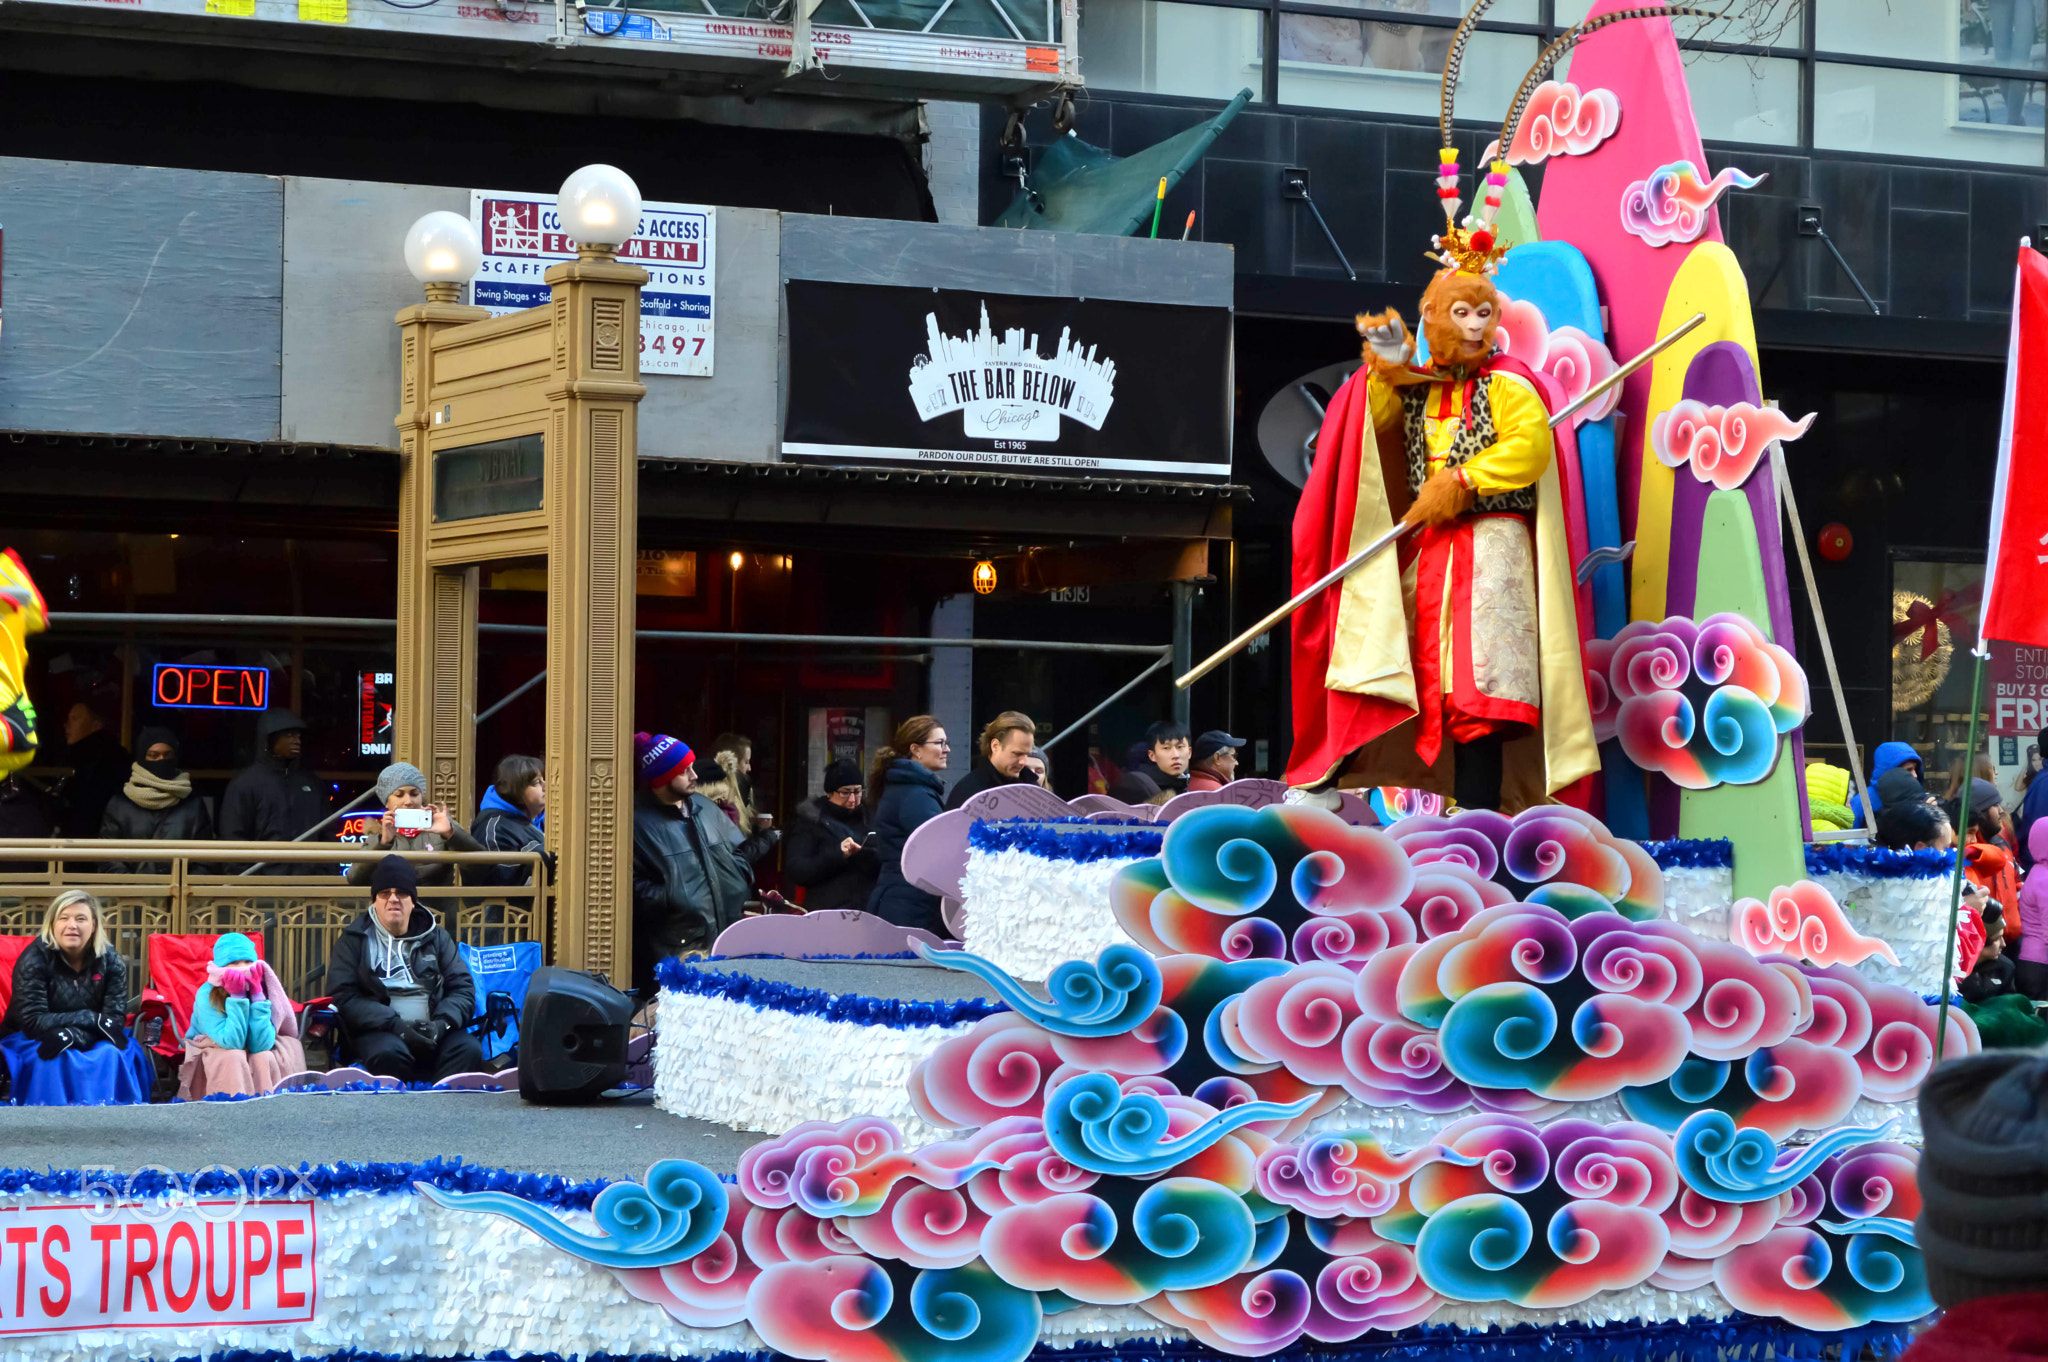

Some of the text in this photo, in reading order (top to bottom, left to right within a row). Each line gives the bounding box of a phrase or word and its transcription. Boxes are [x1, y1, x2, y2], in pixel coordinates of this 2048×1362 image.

[705, 24, 851, 45] CONTRACTORS CCESS
[649, 219, 699, 240] ACCESS
[550, 235, 691, 260] EQMENT
[476, 288, 501, 301] Swing
[503, 289, 530, 303] Stages
[640, 298, 671, 310] Scaffold
[679, 300, 710, 315] Shoring
[697, 323, 706, 332] IL
[1024, 362, 1042, 370] GRILL
[948, 368, 1076, 410] THE BAR BELOW
[980, 408, 1040, 432] Chicago
[994, 440, 1027, 450] Est 1965
[918, 450, 1100, 467] PARDON OUR DUST, BUT WE ARE STILL OPEN!
[2015, 648, 2048, 662] ENTI
[2015, 665, 2048, 679] STO
[158, 667, 264, 707] OPEN
[1996, 683, 2026, 696] BUY
[2028, 684, 2037, 697] 3
[362, 673, 375, 743] REVOLUTION
[642, 736, 679, 766] CHICA
[0, 1219, 306, 1319] TS TROUPE
